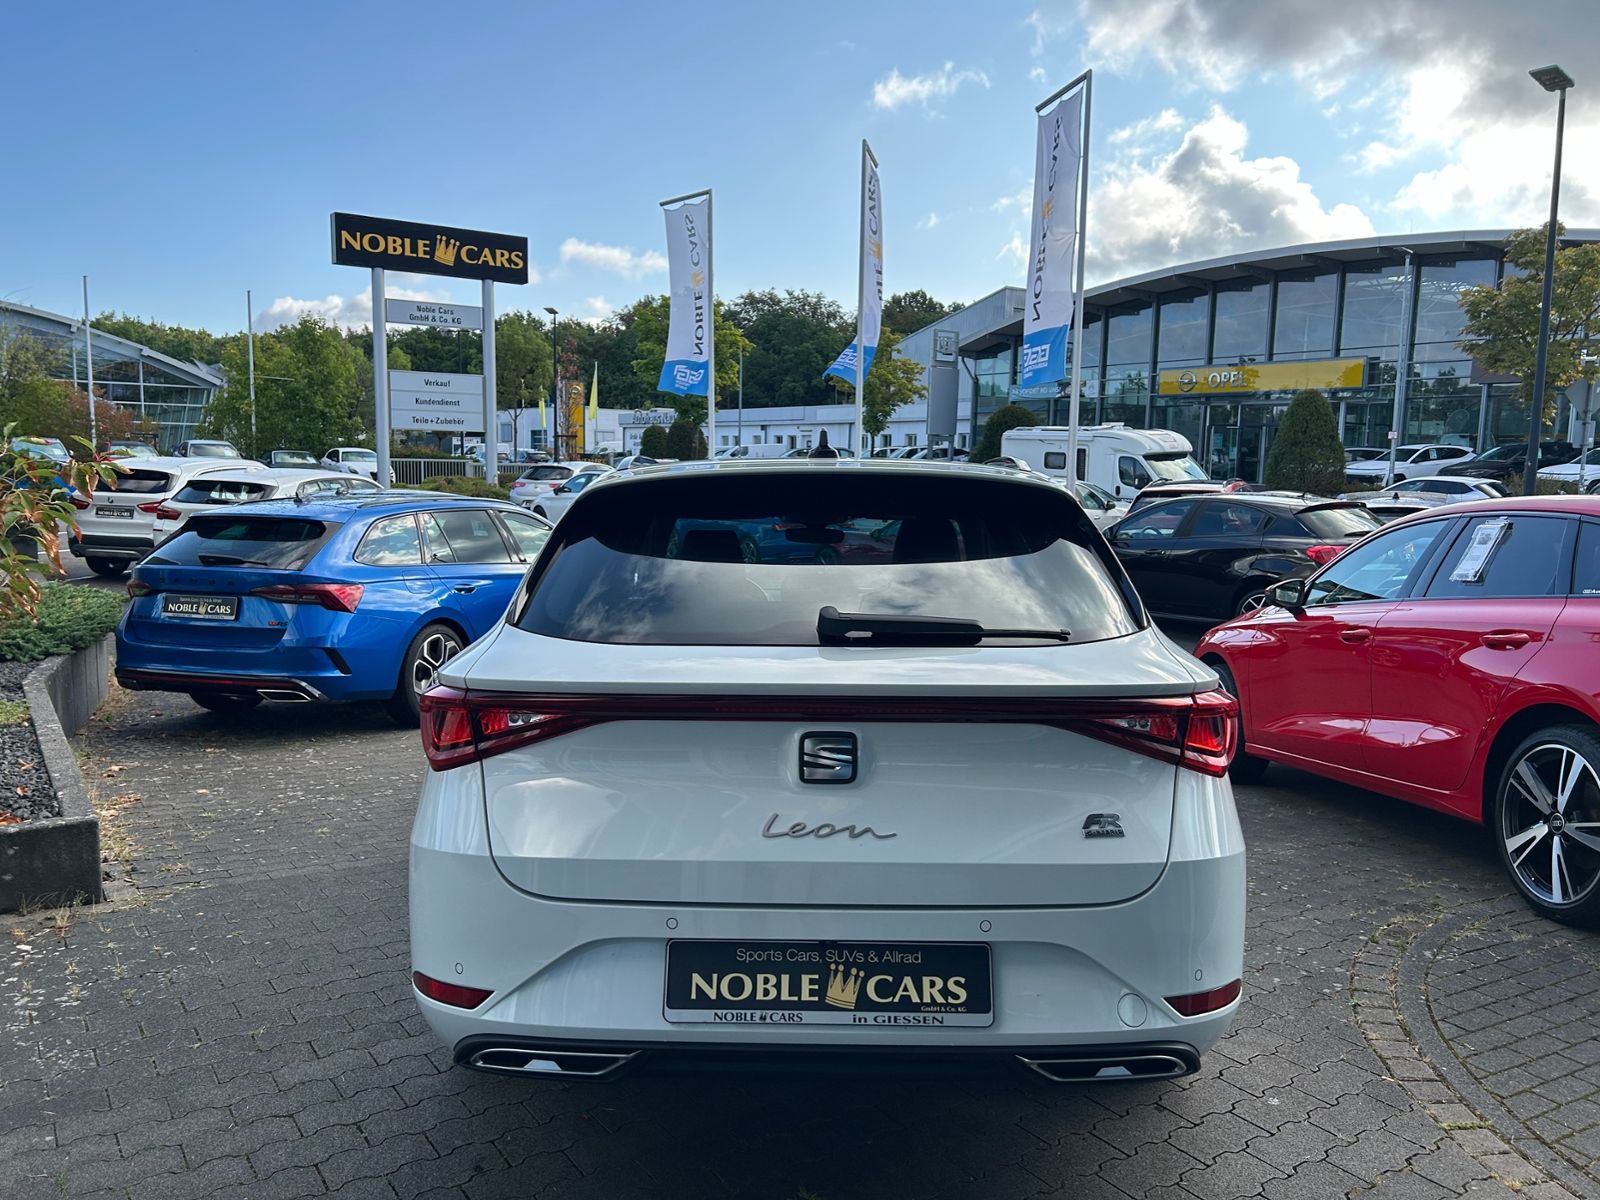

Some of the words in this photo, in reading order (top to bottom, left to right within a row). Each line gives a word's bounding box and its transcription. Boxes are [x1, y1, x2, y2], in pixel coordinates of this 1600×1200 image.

[341, 230, 430, 258] NOBLE
[460, 245, 524, 269] CARS
[416, 305, 435, 314] Noble
[438, 307, 454, 315] Cars
[409, 314, 429, 322] GmbH
[452, 317, 461, 325] KG
[424, 379, 450, 387] Verkauf
[1208, 371, 1248, 388] OPEL
[415, 397, 460, 407] Kundendienst
[168, 603, 198, 612] NOBLE
[207, 605, 231, 614] CARS
[762, 812, 897, 839] Leon
[1082, 813, 1122, 829] FR
[736, 949, 783, 963] Sports
[786, 949, 822, 963] Cars,
[825, 949, 865, 962] SUVs
[868, 951, 879, 962] &
[882, 951, 921, 963] Allrad
[690, 972, 819, 1001] NOBLE
[866, 974, 967, 1004] CARS
[713, 1011, 756, 1022] NOBLE
[769, 1012, 803, 1022] CARS
[852, 1014, 868, 1024] in
[873, 1014, 944, 1025] GIESSEN
